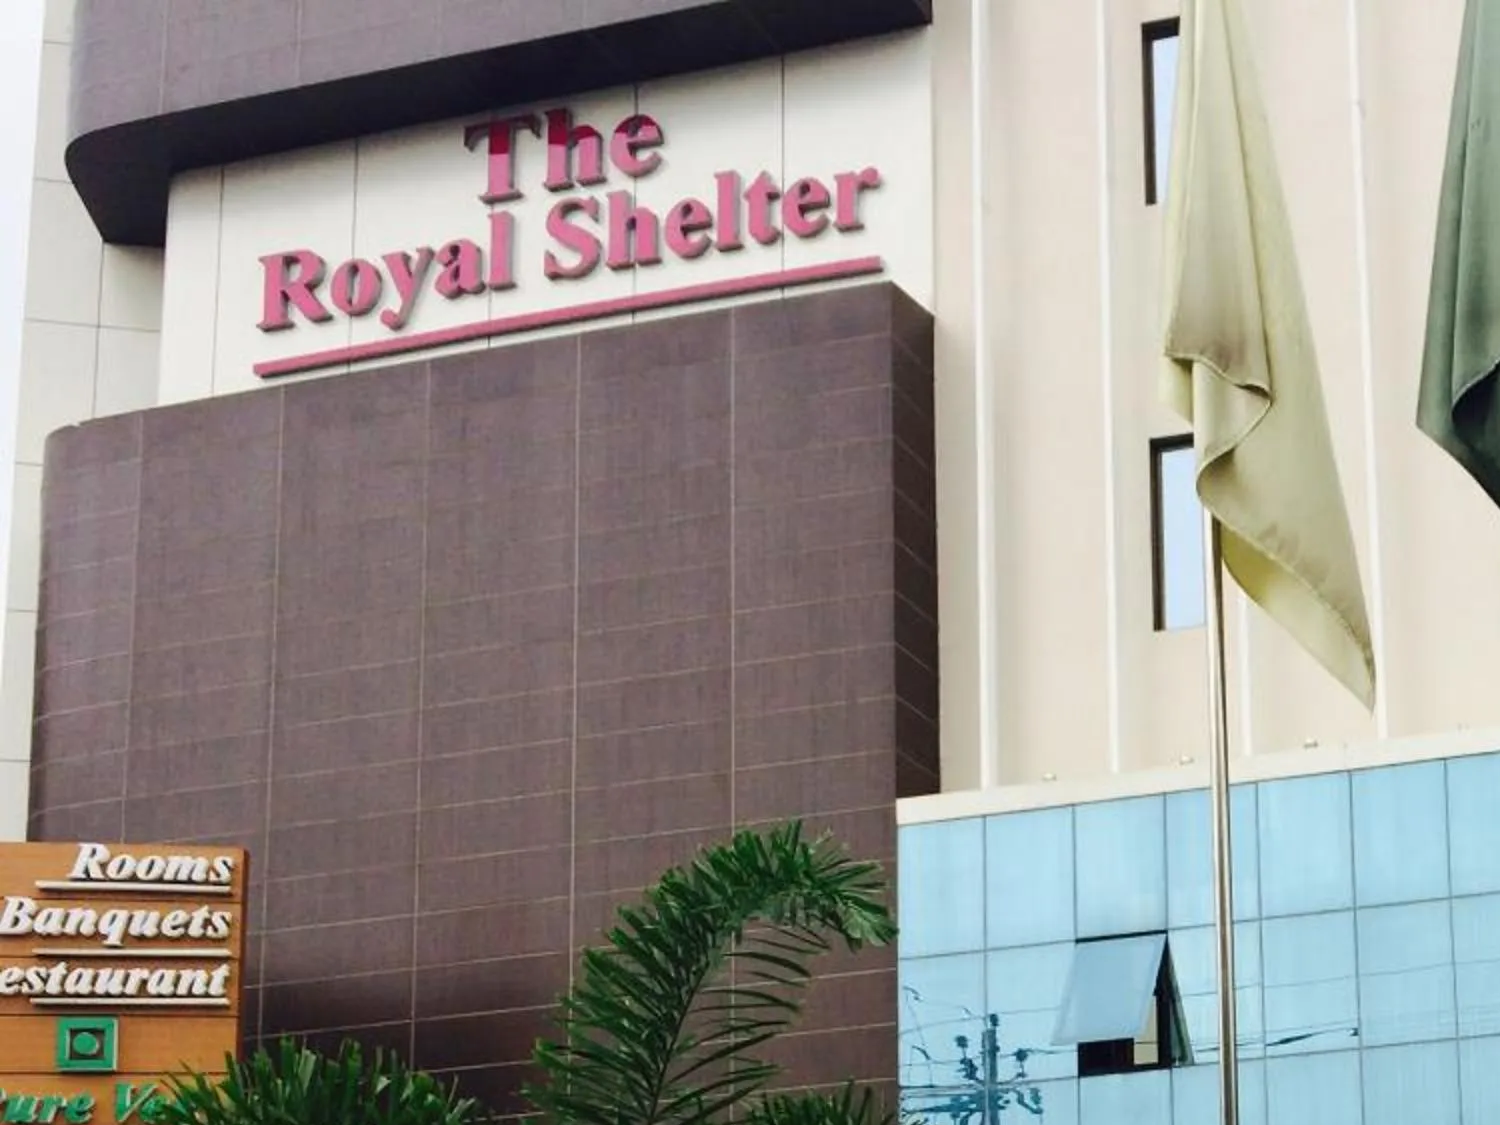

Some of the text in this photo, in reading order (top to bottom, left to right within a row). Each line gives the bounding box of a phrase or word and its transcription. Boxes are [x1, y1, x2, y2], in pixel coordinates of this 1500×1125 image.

[463, 107, 666, 204] The
[255, 165, 884, 332] Royal Shelter
[68, 842, 234, 884] Rooms
[0, 895, 233, 948] Banquets
[0, 959, 230, 998] estaurant
[114, 1081, 188, 1125] Ve
